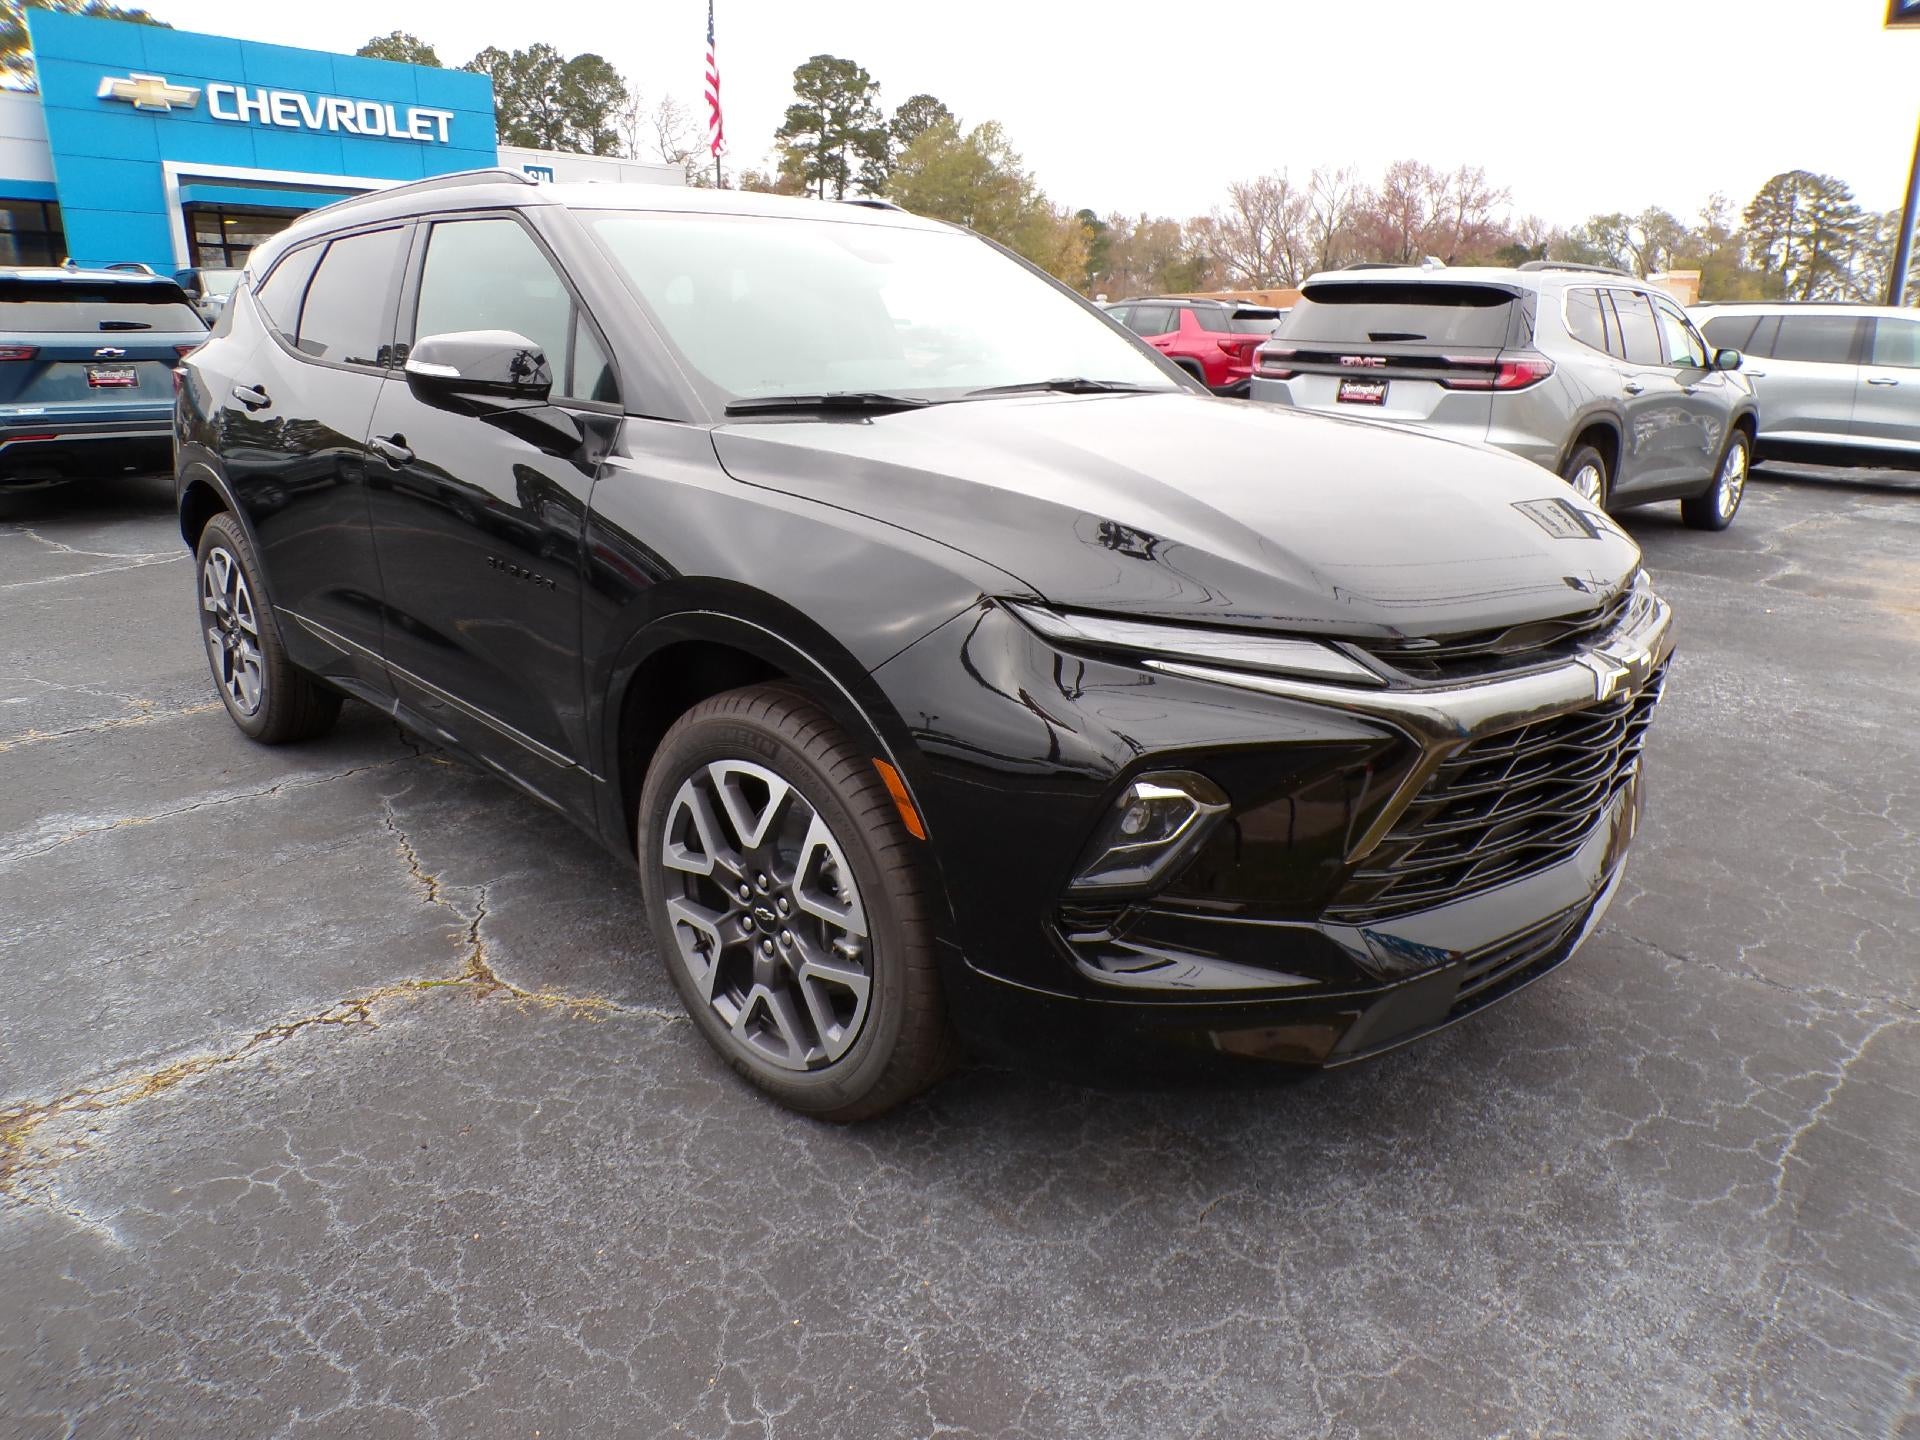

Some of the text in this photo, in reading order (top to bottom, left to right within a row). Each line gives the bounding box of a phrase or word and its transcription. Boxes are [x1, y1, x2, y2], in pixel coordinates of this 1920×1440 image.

[207, 83, 454, 143] CHEVROLET
[1340, 355, 1386, 368] GMC
[90, 369, 135, 379] Springhill
